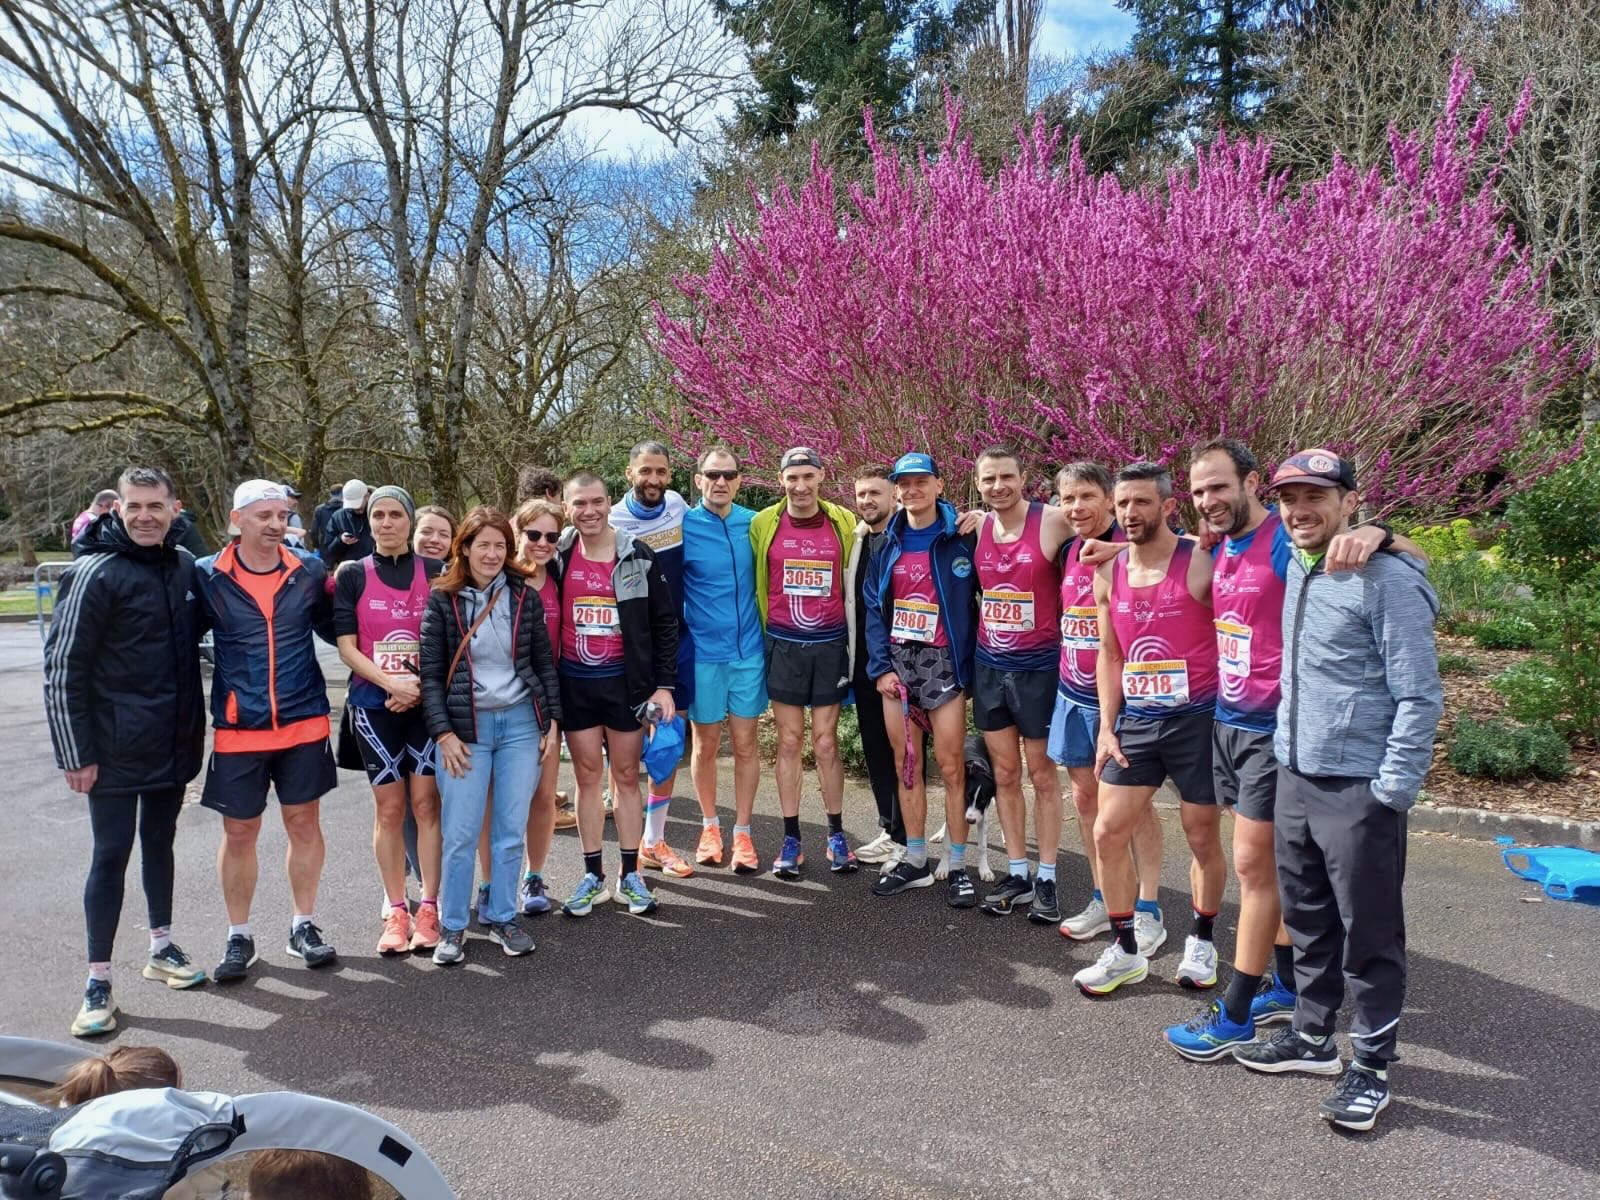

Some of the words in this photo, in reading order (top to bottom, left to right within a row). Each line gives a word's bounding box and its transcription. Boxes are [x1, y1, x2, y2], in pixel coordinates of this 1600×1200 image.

[785, 570, 824, 586] 3055
[576, 607, 612, 624] 2610
[894, 611, 927, 630] 2980
[984, 602, 1022, 621] 2628
[1063, 618, 1100, 637] 2263
[1126, 675, 1172, 695] 3218
